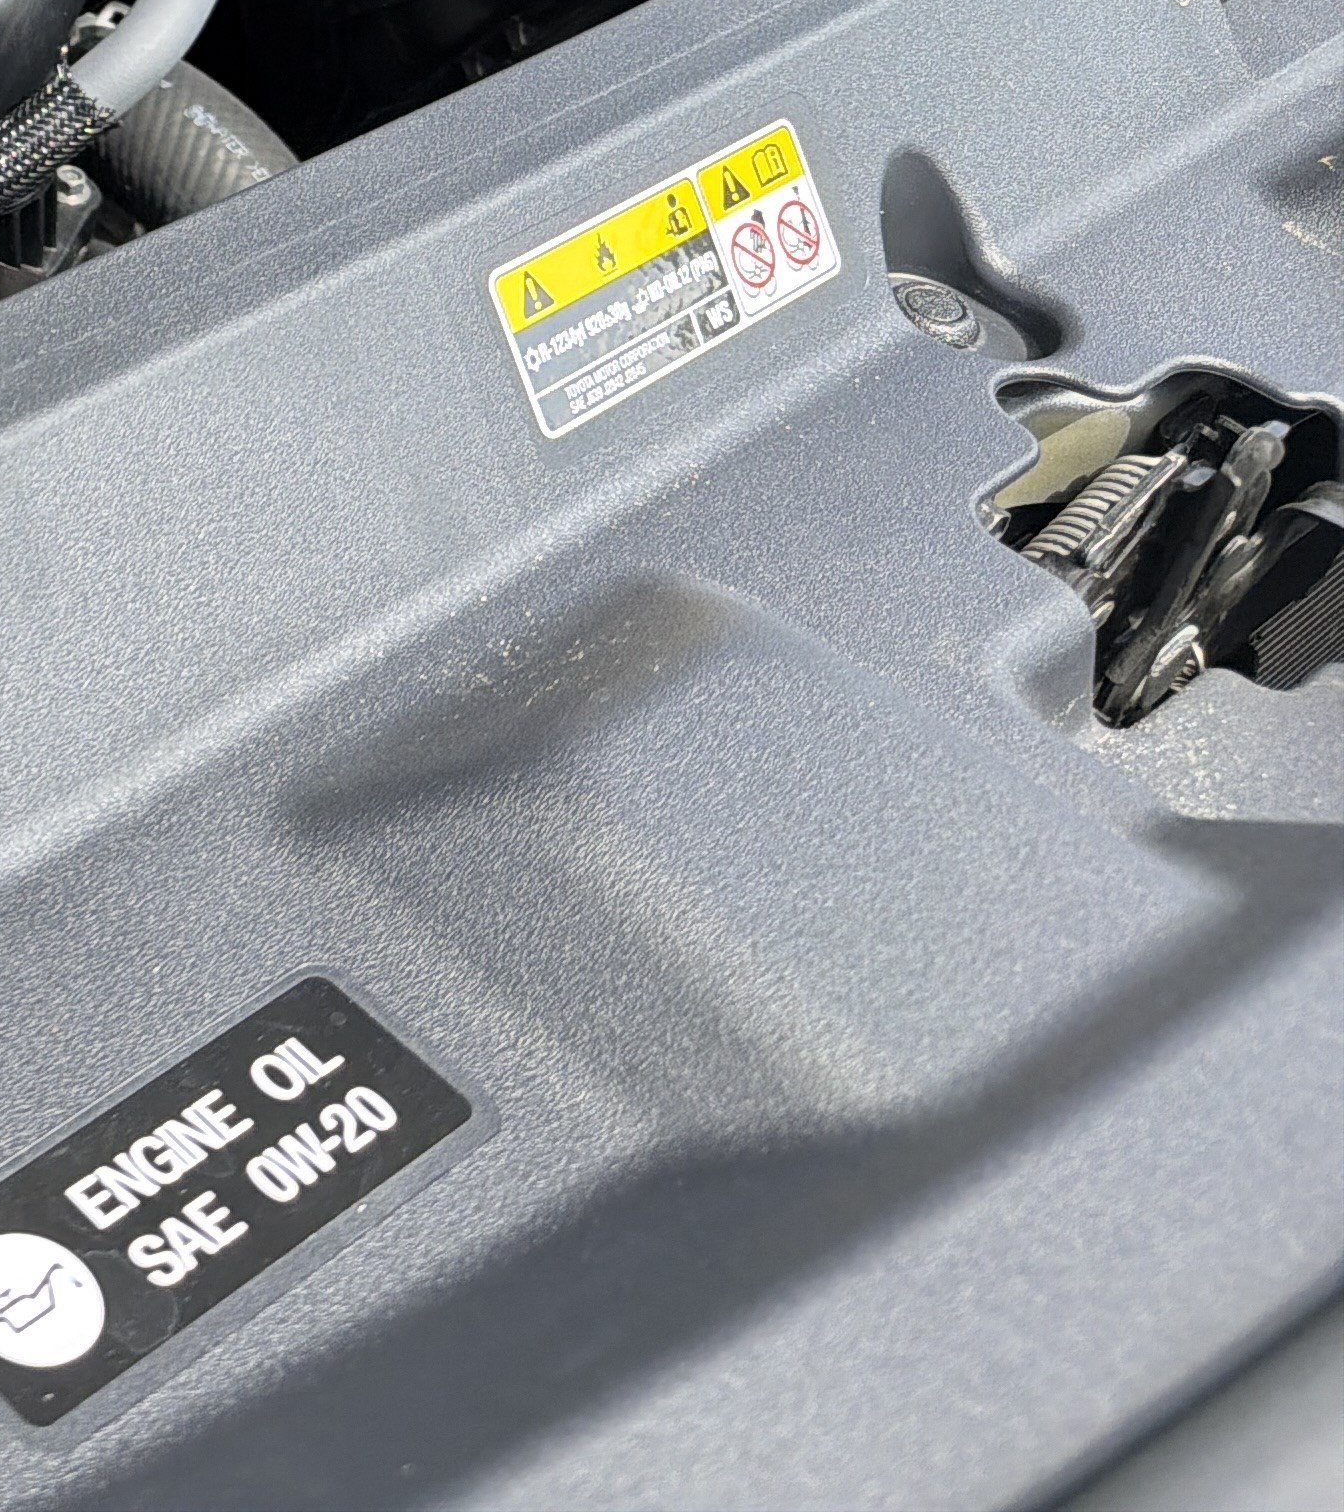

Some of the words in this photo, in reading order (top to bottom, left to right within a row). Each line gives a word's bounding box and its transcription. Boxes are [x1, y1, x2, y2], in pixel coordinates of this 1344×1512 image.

[564, 374, 596, 400] TOYOTA
[593, 359, 621, 385] MOTOR
[619, 331, 670, 371] CORPORATION
[706, 300, 734, 330] WS
[64, 1088, 255, 1231] ENGINE
[250, 1036, 346, 1101] OIL
[128, 1190, 249, 1287] SAE
[246, 1086, 398, 1203] 0W-20
